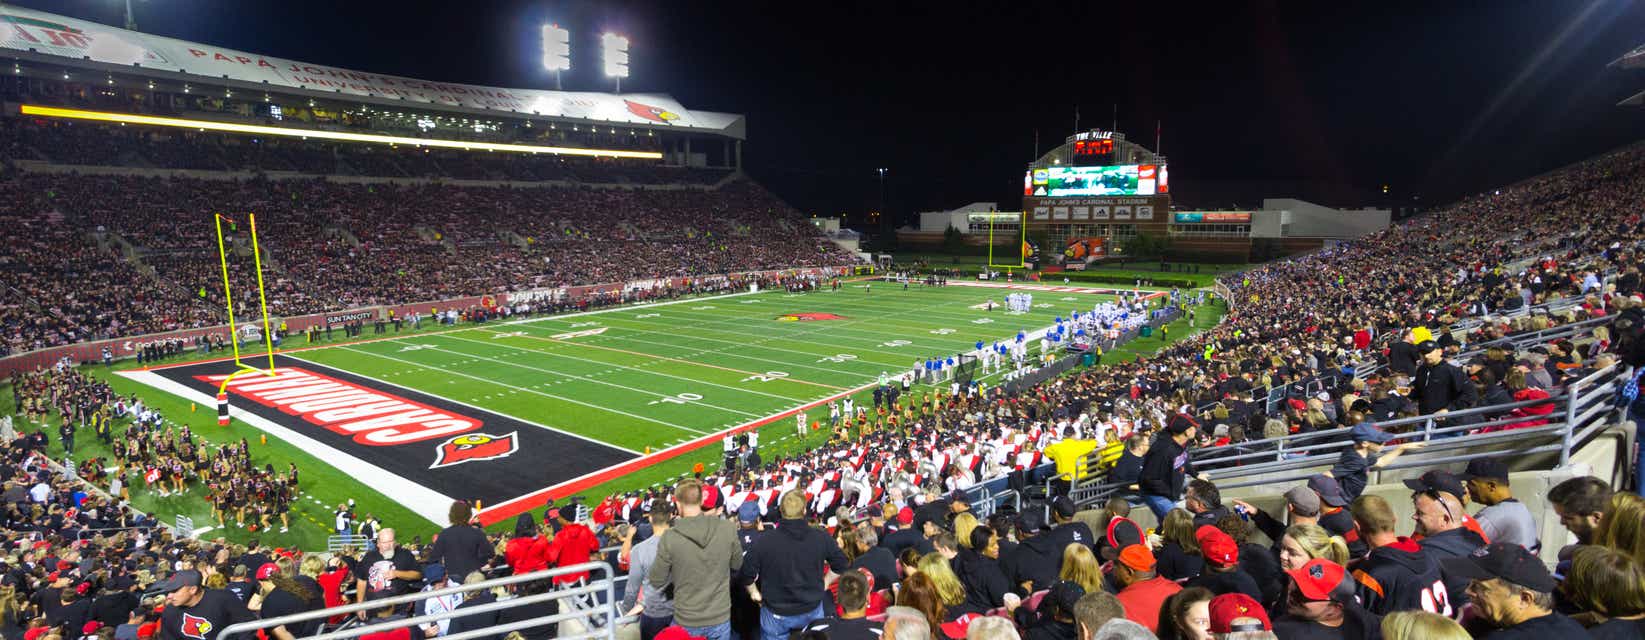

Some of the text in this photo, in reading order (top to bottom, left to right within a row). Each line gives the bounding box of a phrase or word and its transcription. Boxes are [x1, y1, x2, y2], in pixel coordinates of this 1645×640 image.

[188, 48, 276, 69] PAPA
[1092, 131, 1113, 139] VILLE
[661, 393, 703, 404] 10
